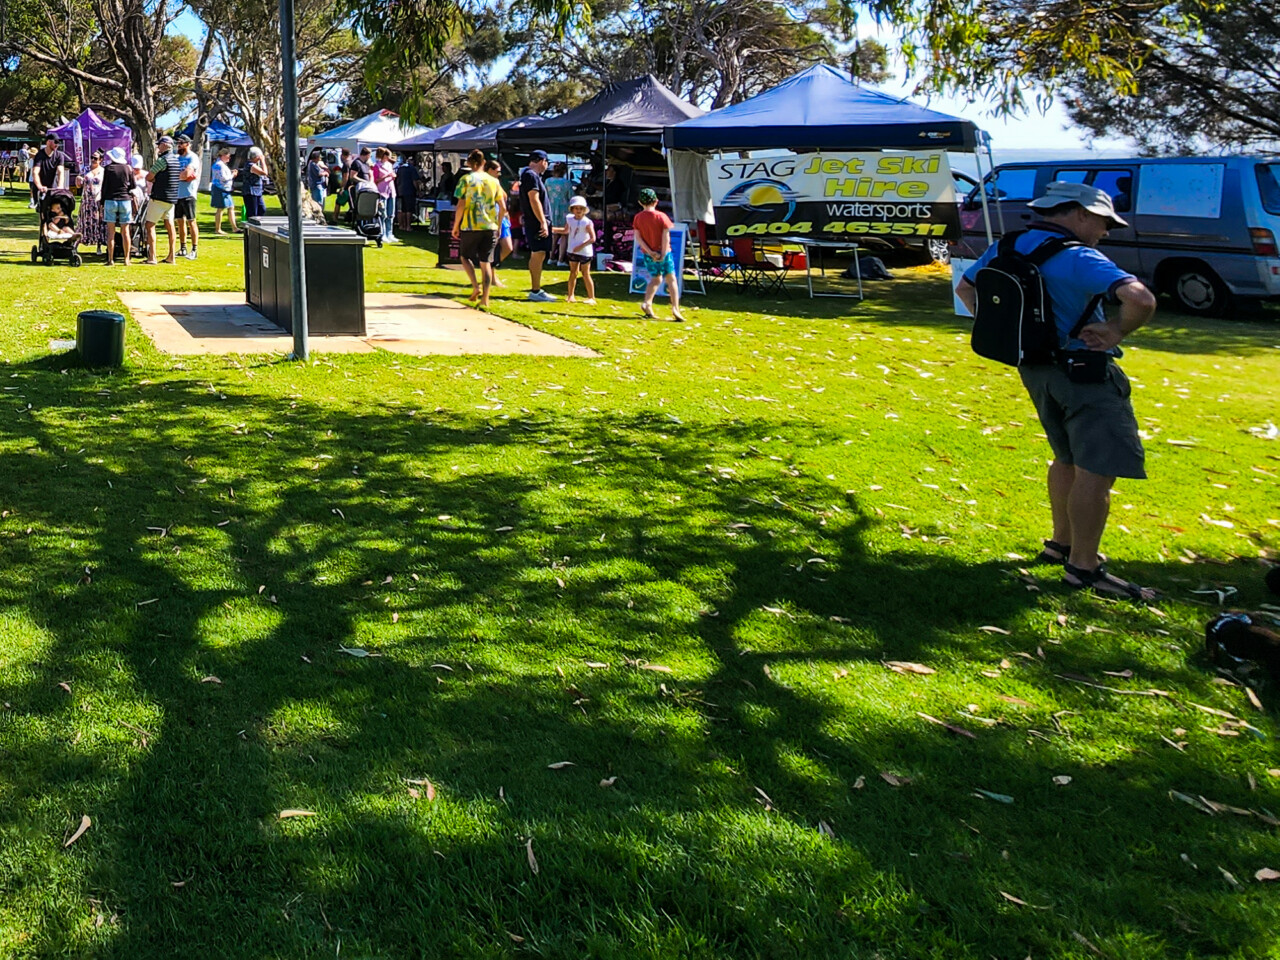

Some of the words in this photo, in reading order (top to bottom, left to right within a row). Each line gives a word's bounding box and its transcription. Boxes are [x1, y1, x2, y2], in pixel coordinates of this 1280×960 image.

[718, 160, 795, 179] STAG
[804, 157, 865, 174] Jet
[876, 154, 941, 174] Ski
[823, 177, 930, 198] Hire
[826, 203, 932, 221] watersports
[726, 222, 812, 236] 0404
[823, 221, 948, 236] 463511
